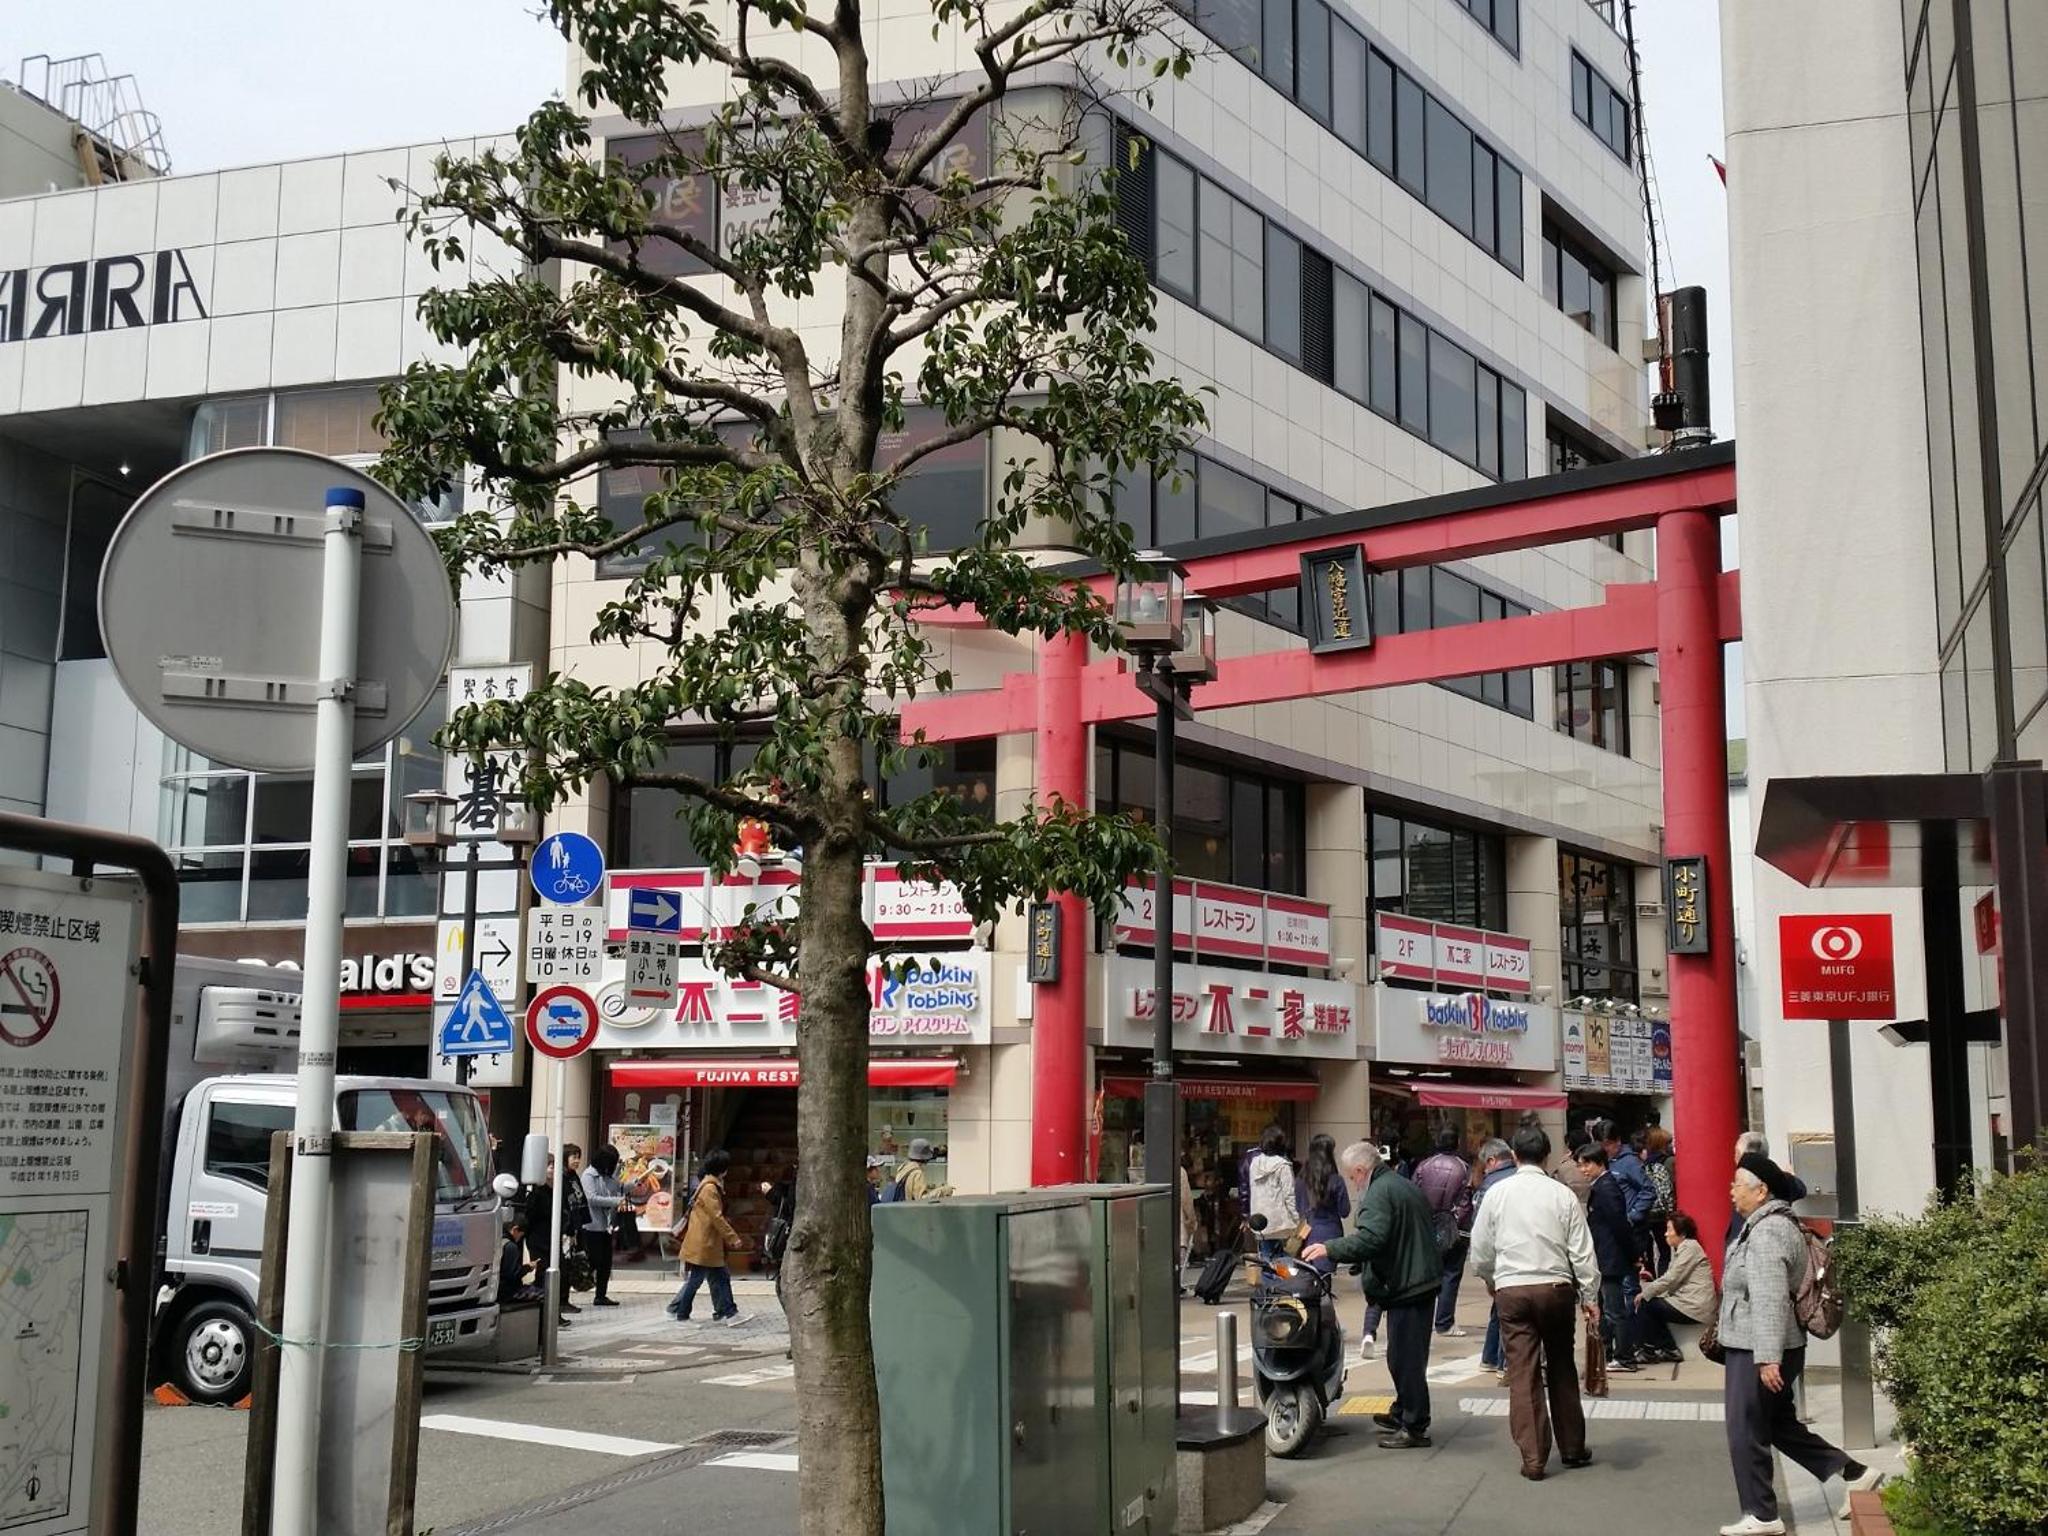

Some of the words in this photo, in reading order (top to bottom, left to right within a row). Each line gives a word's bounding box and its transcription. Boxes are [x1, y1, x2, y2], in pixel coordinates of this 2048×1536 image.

[463, 675, 518, 700] 喫茶室
[898, 886, 952, 898] レストラン
[1675, 865, 1700, 945] 小町通り
[0, 910, 101, 943] 喫煙禁止区域
[539, 914, 592, 928] 平日の
[1203, 906, 1256, 933] レストラン
[1036, 910, 1058, 976] 小町通り
[1398, 938, 1415, 958] 2F
[1445, 944, 1473, 965] 不二家
[1489, 951, 1526, 973] レストラン
[1820, 965, 1855, 976] MUFG
[1787, 990, 1890, 1003] 三菱東京UFJ銀行
[1134, 990, 1199, 1020] レスラン
[1207, 983, 1305, 1039] 不二家
[1314, 1003, 1351, 1034] 洋菓子
[902, 1016, 968, 1032] アイスクリーム
[696, 1071, 751, 1082] FUJIYA
[757, 1071, 799, 1082] REST
[1205, 1086, 1257, 1097] RESTAURANT
